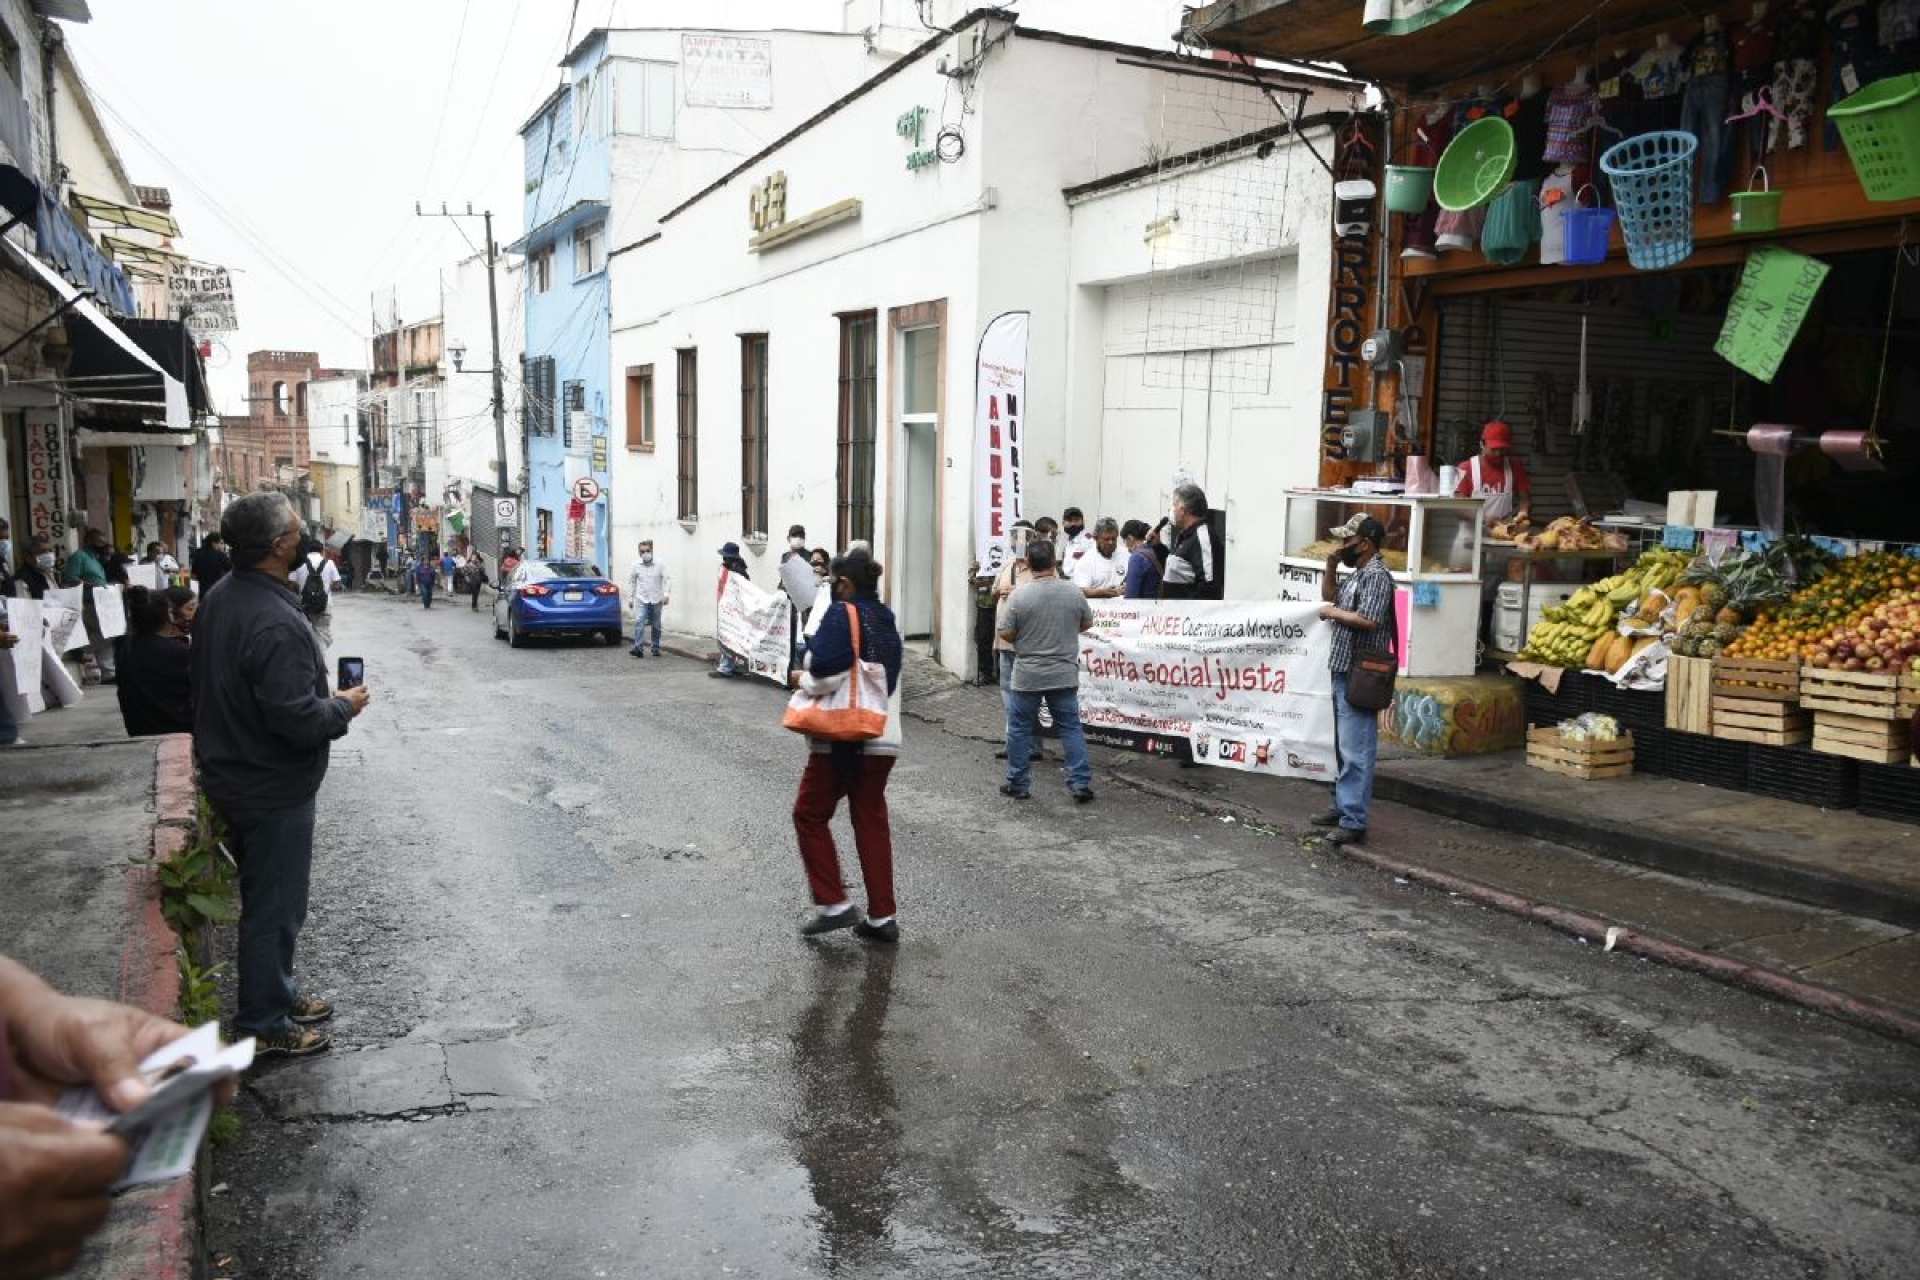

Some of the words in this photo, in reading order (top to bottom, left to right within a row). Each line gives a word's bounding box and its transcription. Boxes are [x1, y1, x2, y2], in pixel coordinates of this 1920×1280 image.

[168, 276, 198, 292] ESTA
[201, 274, 232, 292] CASA
[27, 423, 47, 495] TACOS
[1140, 615, 1181, 637] ANUEE
[1081, 648, 1139, 683] Tarifa
[1142, 655, 1212, 689] social
[1215, 657, 1286, 701] justa
[1220, 741, 1246, 762] OPT
